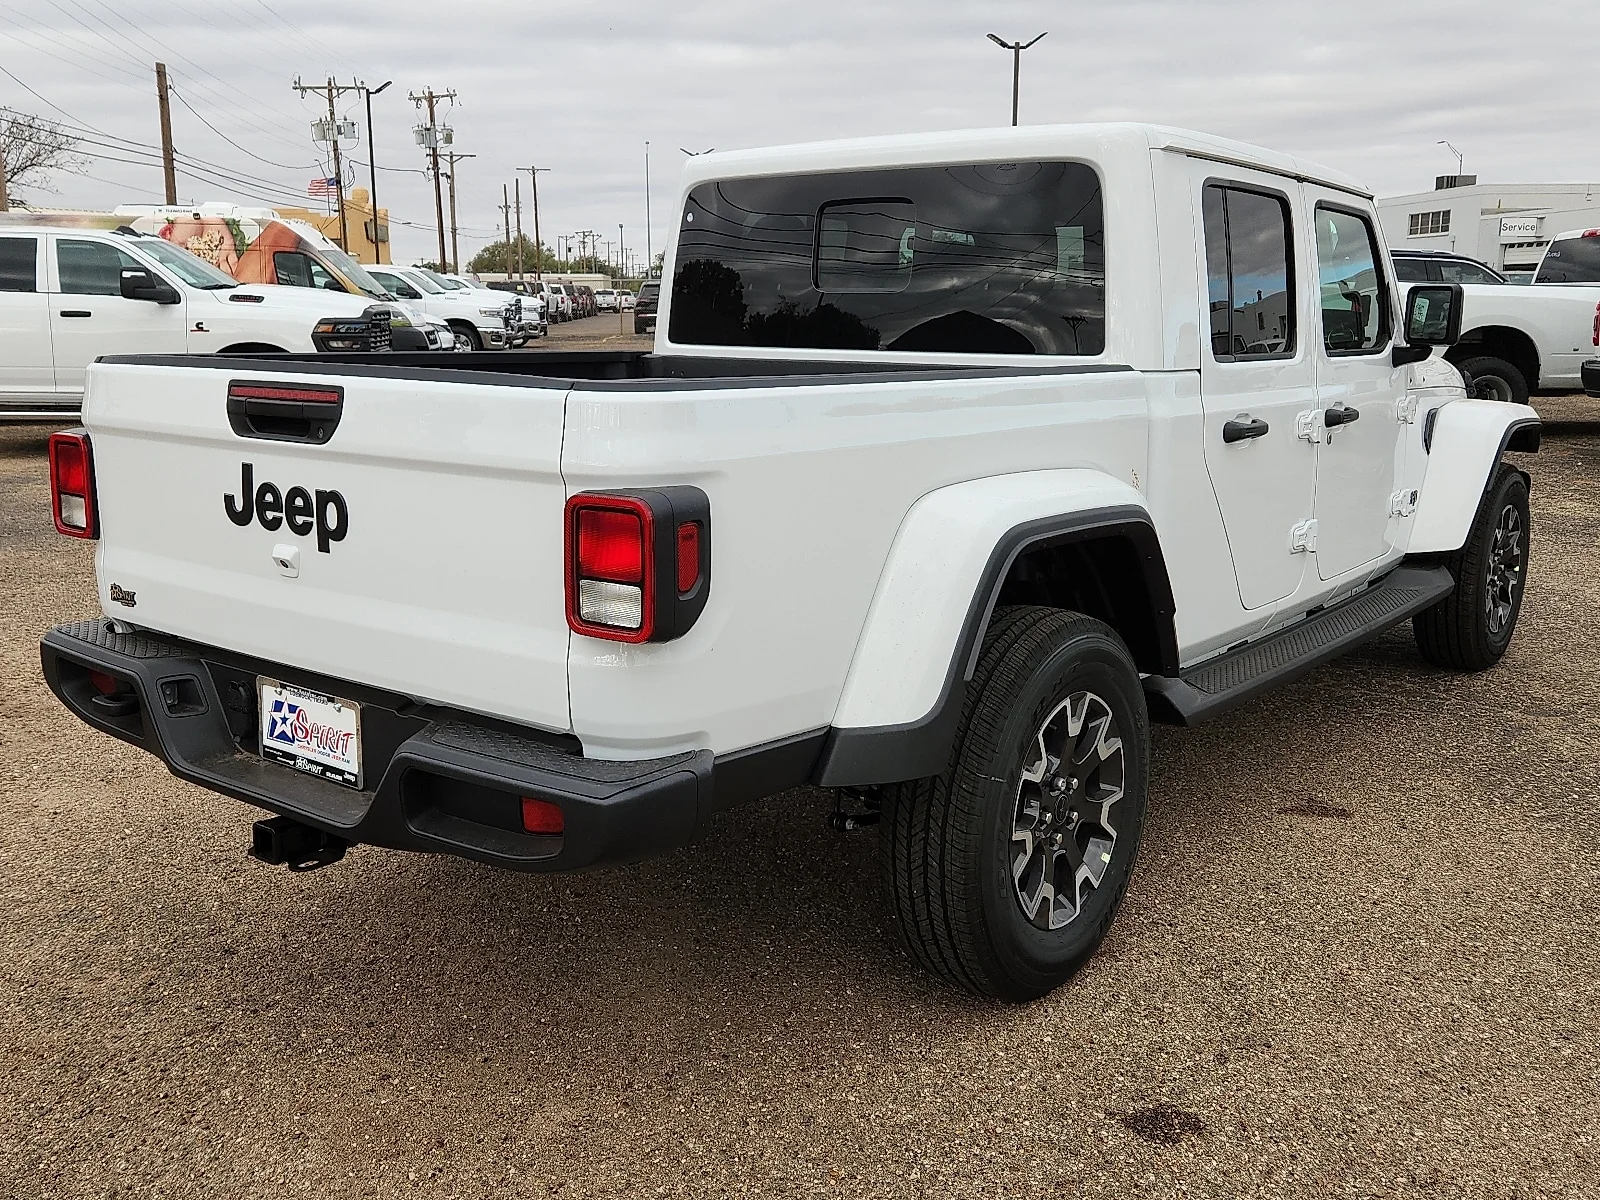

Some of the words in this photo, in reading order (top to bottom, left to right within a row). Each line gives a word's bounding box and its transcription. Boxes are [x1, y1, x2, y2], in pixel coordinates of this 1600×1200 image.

[1501, 222, 1536, 231] Service
[223, 461, 349, 554] Jeep
[294, 708, 355, 756] SPIRIT
